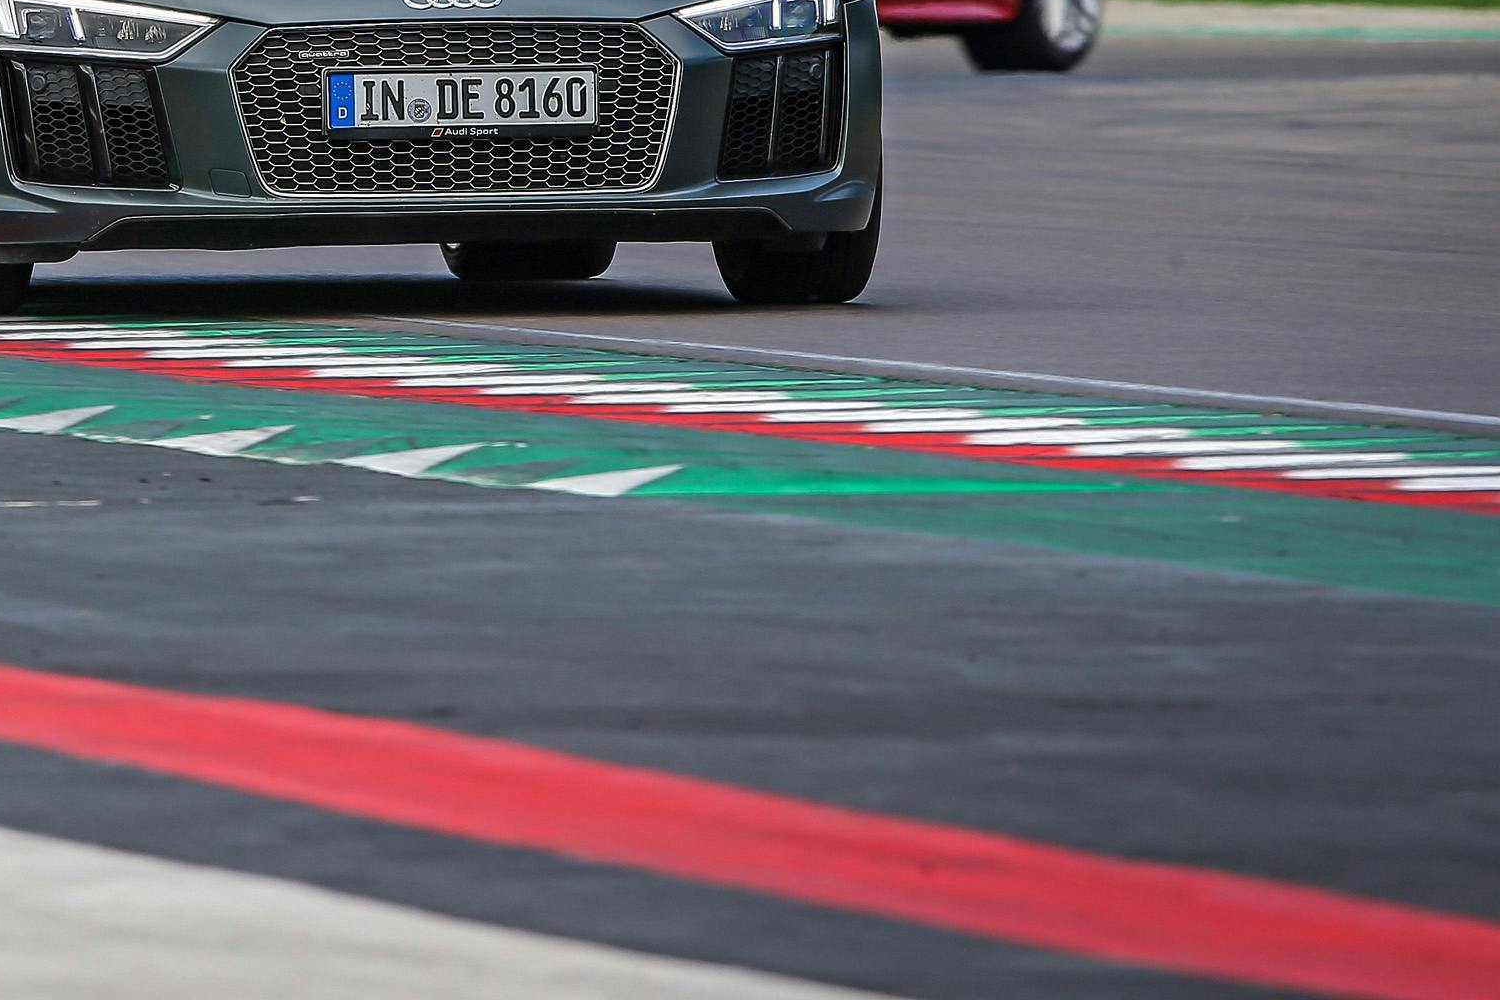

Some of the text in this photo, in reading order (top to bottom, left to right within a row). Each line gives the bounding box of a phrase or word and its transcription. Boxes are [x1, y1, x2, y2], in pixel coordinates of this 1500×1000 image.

[300, 50, 348, 59] quattro
[360, 77, 586, 121] IN DE 8160
[338, 107, 348, 119] D
[444, 127, 499, 137] Audi Sport
